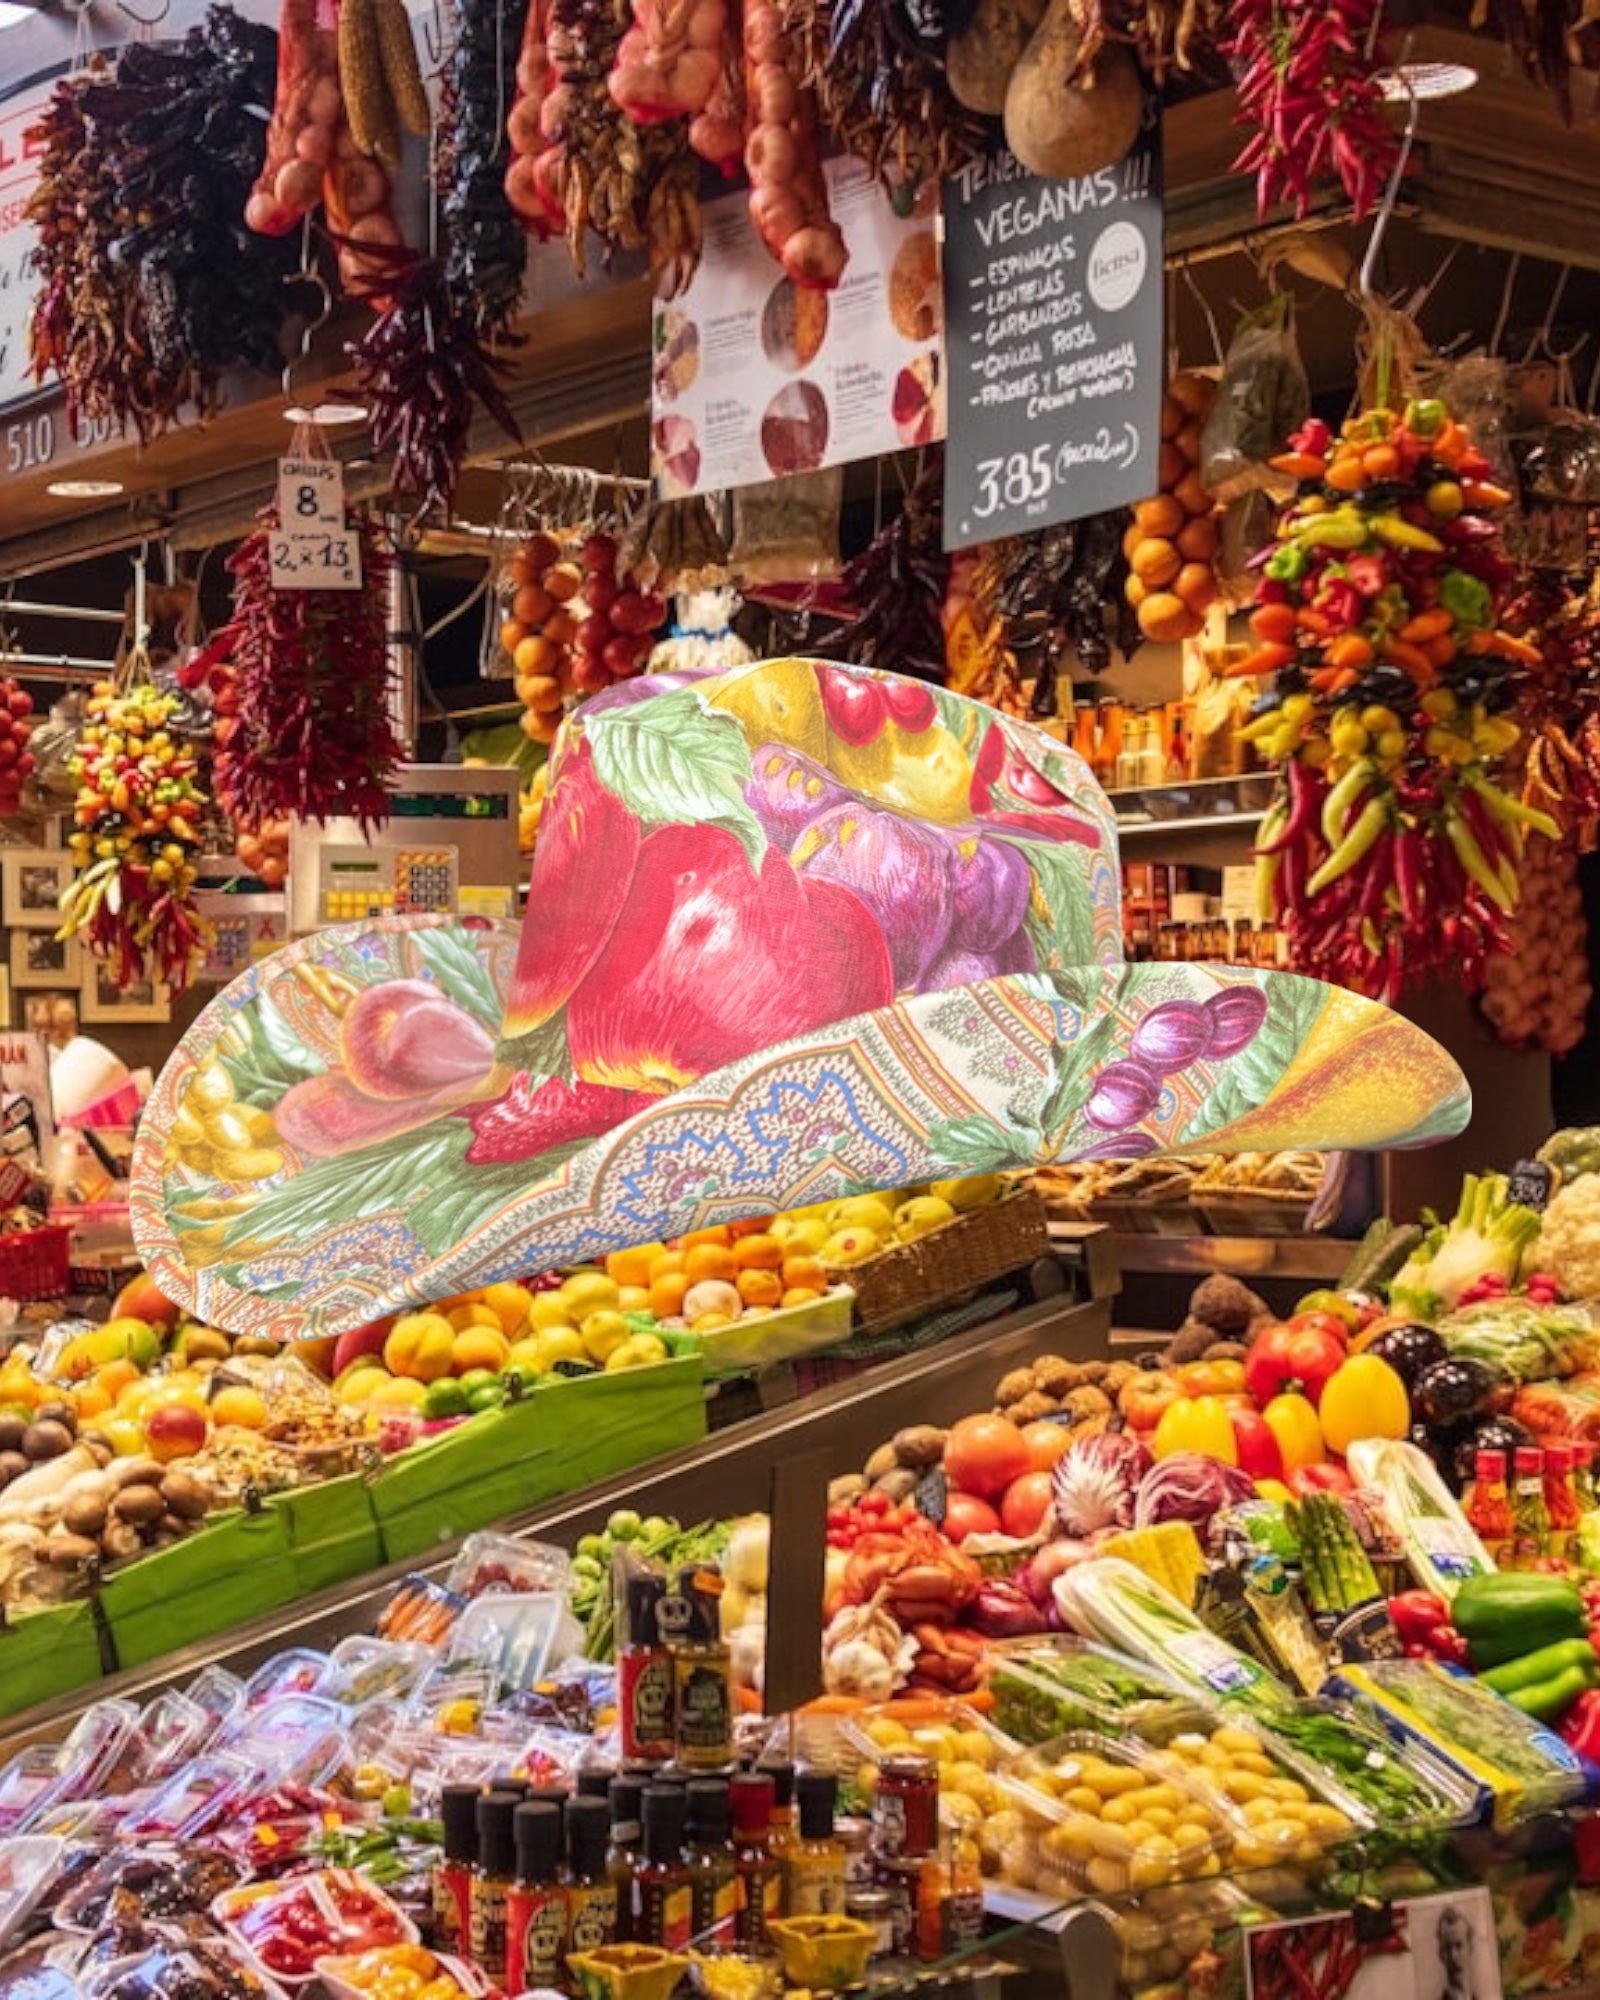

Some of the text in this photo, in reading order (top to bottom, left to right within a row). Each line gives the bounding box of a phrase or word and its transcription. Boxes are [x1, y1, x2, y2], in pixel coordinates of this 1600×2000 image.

[7, 413, 53, 473] 510
[297, 486, 318, 517] 8
[317, 541, 349, 568] 13
